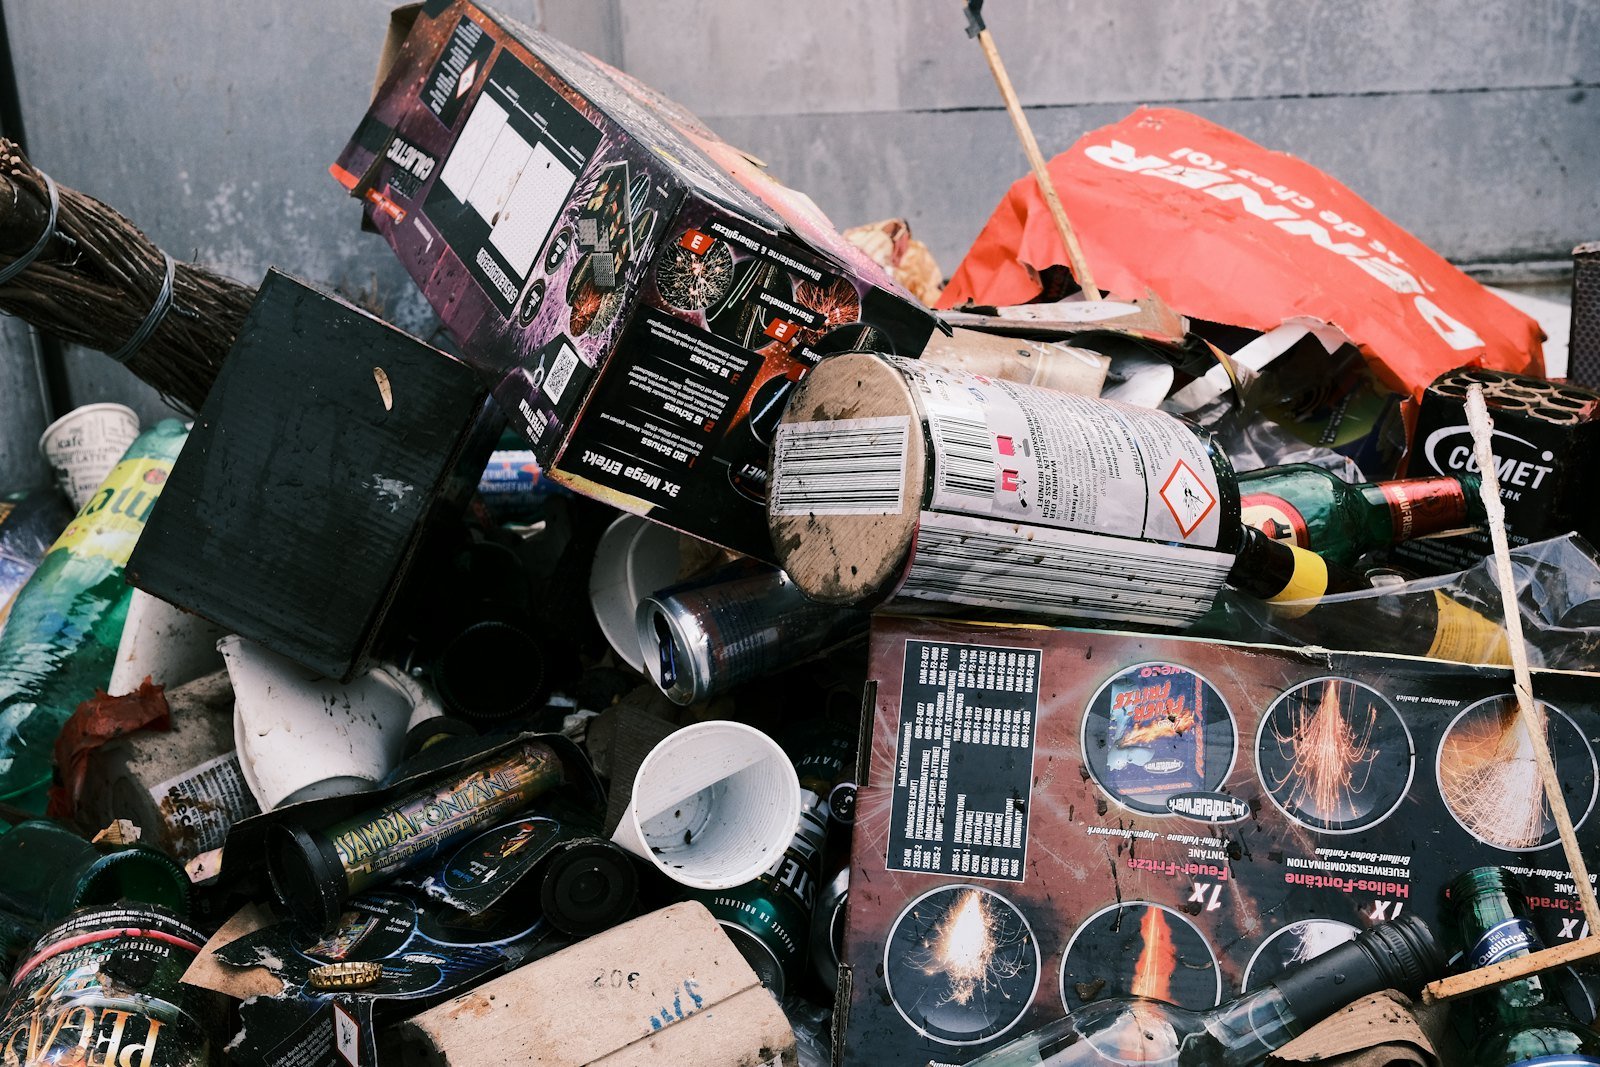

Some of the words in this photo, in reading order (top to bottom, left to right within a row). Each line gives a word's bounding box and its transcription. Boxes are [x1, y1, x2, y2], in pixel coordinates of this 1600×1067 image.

[689, 233, 703, 249] 3
[710, 219, 761, 251] Silberglitzer
[759, 244, 767, 254] &
[766, 248, 822, 281] Blumensterne
[758, 291, 814, 323] Sternkometen
[773, 322, 788, 338] 2
[688, 353, 720, 373] Schuss
[718, 366, 730, 378] 16
[517, 397, 544, 438] EFFEKTFILM
[662, 401, 694, 421] Schuss
[692, 413, 703, 425] 16
[703, 419, 715, 433] 2
[639, 436, 673, 456] Schuss
[672, 449, 688, 462] 120
[580, 448, 623, 476] Effekt
[737, 461, 768, 483] MET
[622, 462, 662, 490] Mega
[1044, 474, 1052, 496] DASS
[660, 480, 681, 498] 3x
[1395, 693, 1419, 703] ähnlich
[1420, 695, 1460, 706] Abbildungen
[942, 736, 950, 748] MIT
[903, 848, 911, 867] 3214N
[909, 779, 918, 799] LICHT]
[919, 646, 930, 684] BAM-F2-0277
[168, 785, 195, 836] wec
[954, 793, 965, 843] [KOMBINATION]
[963, 810, 974, 843] [FONTÄNE]
[972, 810, 983, 844] [FONTÄNE]
[982, 811, 993, 845] [FONTÄNE]
[992, 812, 1003, 846] [FONTÄNE]
[1003, 798, 1014, 847] [KOMBINATION]
[1167, 833, 1221, 847] Mini-Vulkane
[913, 844, 922, 868] 3233S-2
[1286, 856, 1410, 878] FEUERWERKSKOMBINATION
[1314, 846, 1410, 868] Brillant-Boden-Fontäne
[1126, 856, 1228, 881] Feuer-Fritze
[1283, 871, 1409, 898] Helios-Fontäne
[1186, 881, 1223, 912] 1x
[758, 911, 770, 923] EN
[1488, 930, 1504, 943] Hell
